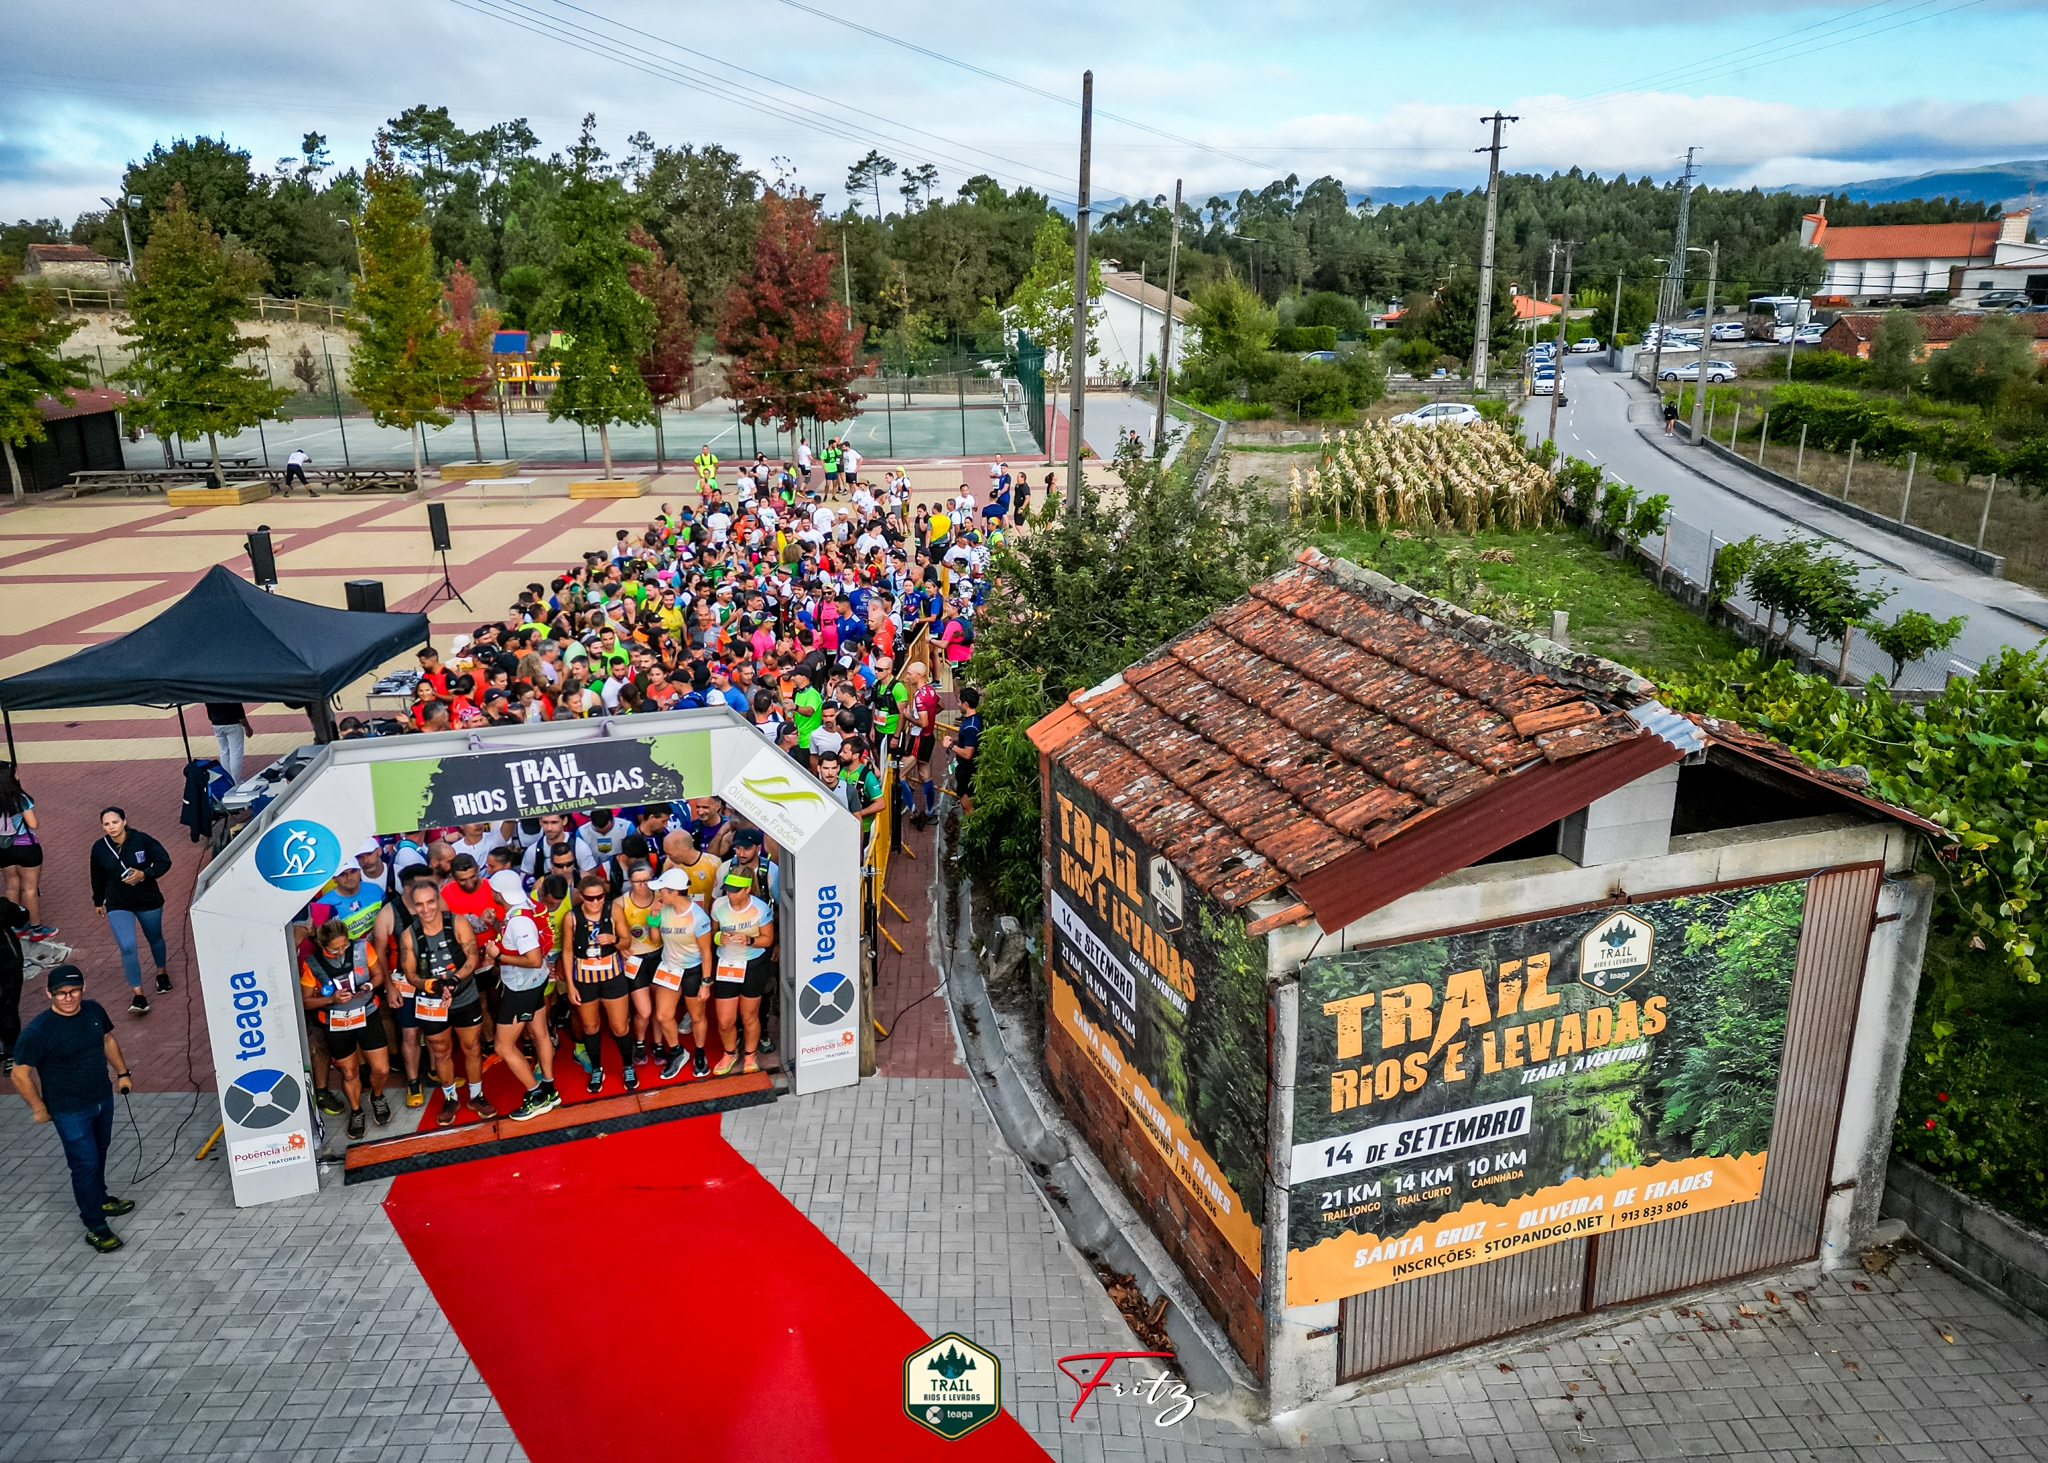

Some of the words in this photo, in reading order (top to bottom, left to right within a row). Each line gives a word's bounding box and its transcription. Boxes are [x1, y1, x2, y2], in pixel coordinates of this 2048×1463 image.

[505, 753, 586, 786] TRAIL
[452, 789, 507, 816] RIOS
[513, 786, 528, 808] E
[533, 767, 644, 806] LEVADAS
[551, 797, 597, 812] AVENTURA
[728, 785, 762, 817] Oliveira
[761, 815, 769, 823] de
[769, 819, 797, 845] Frades
[1056, 791, 1142, 907] TRAIL
[812, 885, 843, 964] teaga
[1061, 847, 1093, 906] RIOS
[1098, 881, 1107, 922] E
[1112, 895, 1196, 1002] LEVADAS
[1062, 908, 1072, 932] 14
[1075, 928, 1082, 947] DE
[1084, 933, 1133, 1003] SETEMBRO
[1070, 951, 1082, 976] KM
[1601, 947, 1632, 959] TRAIL
[1613, 957, 1637, 966] LEVADAS
[1085, 969, 1093, 988] 14
[1095, 980, 1107, 1006] KM
[1129, 951, 1149, 979] TEAGA
[1151, 973, 1187, 1015] AVENTURA
[1610, 971, 1630, 980] teaga
[230, 970, 268, 1061] teaga
[1111, 1000, 1120, 1020] 10
[1122, 1012, 1135, 1039] KM
[1323, 952, 1560, 1060] TRAIL
[802, 1043, 835, 1054] Potência
[837, 1040, 854, 1048] Ide
[1331, 1051, 1429, 1113] RIOS
[1444, 1041, 1466, 1083] E
[1482, 996, 1667, 1074] LEVADAS
[1521, 1061, 1566, 1085] TEAGA
[1573, 1043, 1648, 1072] AVENTURA
[1074, 1009, 1098, 1049] SANTA
[1134, 1085, 1172, 1143] OLIVEIRA
[1177, 1138, 1189, 1162] DE
[1192, 1156, 1231, 1215] FRADES
[235, 1148, 280, 1162] Potência
[1121, 1086, 1174, 1157] STOPANDGO.NET
[1181, 1165, 1191, 1184] 913
[1204, 1195, 1217, 1217] 806
[1325, 1141, 1353, 1168] 14
[1366, 1143, 1388, 1164] DE
[1394, 1106, 1526, 1157] SETEMBRO
[268, 1156, 300, 1165] TRATORES
[1394, 1174, 1415, 1194] 14
[1421, 1166, 1453, 1188] KM
[1468, 1158, 1490, 1177] 10
[1495, 1149, 1527, 1171] KM
[1471, 1169, 1524, 1188] CAMINHADA
[1320, 1190, 1341, 1210] 21
[1348, 1181, 1381, 1204] KM
[1322, 1208, 1347, 1222] TRAIL
[1349, 1202, 1381, 1217] LONGO
[1396, 1193, 1420, 1206] TRAIL
[1422, 1186, 1452, 1201] CURTO
[1354, 1236, 1424, 1268] SANTA
[1434, 1221, 1487, 1249] CRUZ
[1518, 1195, 1604, 1230] OLIVEIRA
[1613, 1187, 1638, 1208] DE
[1644, 1170, 1714, 1201] FRADES
[1392, 1249, 1476, 1276] INSCRIÇÕES:
[1484, 1215, 1604, 1253] STOPANDGO.NET
[1621, 1209, 1639, 1222] 913
[1643, 1205, 1663, 1218] 833
[1666, 1199, 1689, 1213] 806
